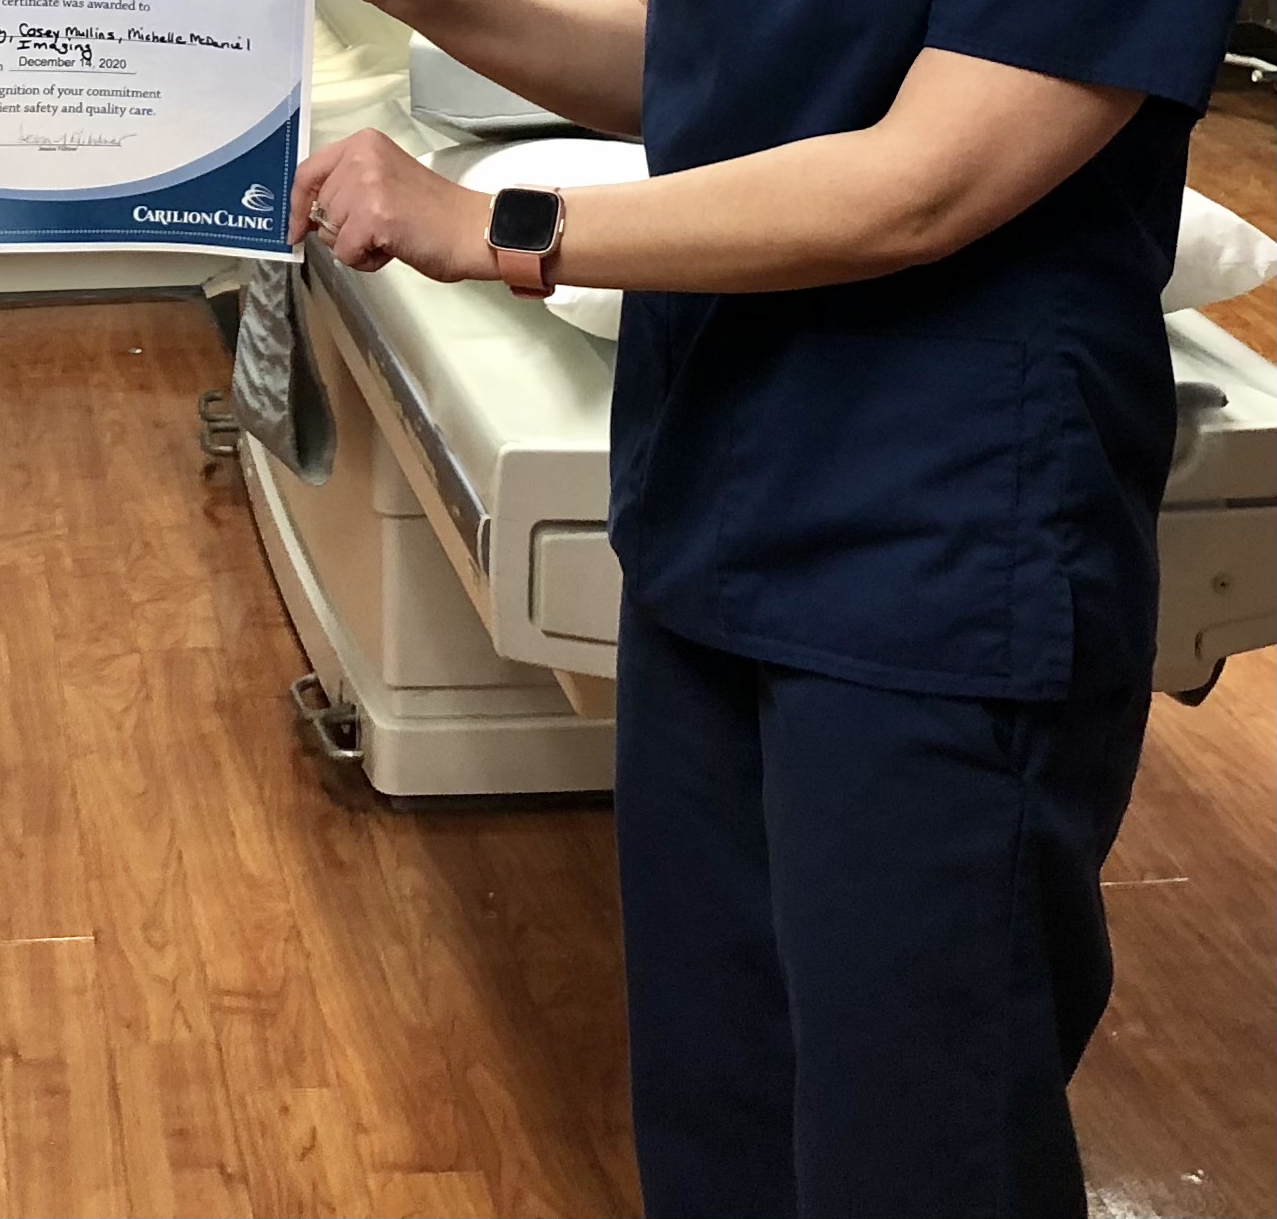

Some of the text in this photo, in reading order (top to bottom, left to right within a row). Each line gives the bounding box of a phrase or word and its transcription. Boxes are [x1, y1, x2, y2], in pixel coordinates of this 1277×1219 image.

[62, 0, 85, 9] was
[87, 0, 136, 11] awarded
[138, 2, 151, 12] to
[19, 23, 60, 43] Casey
[127, 26, 187, 45] Michelle
[17, 38, 92, 61] Imaging
[19, 56, 76, 68] December
[99, 58, 127, 69] 2020
[43, 84, 55, 95] of
[57, 87, 84, 99] your
[86, 86, 162, 99] commitment
[23, 102, 59, 116] safety
[61, 102, 83, 114] and
[85, 103, 127, 117] quality
[129, 106, 156, 116] care.
